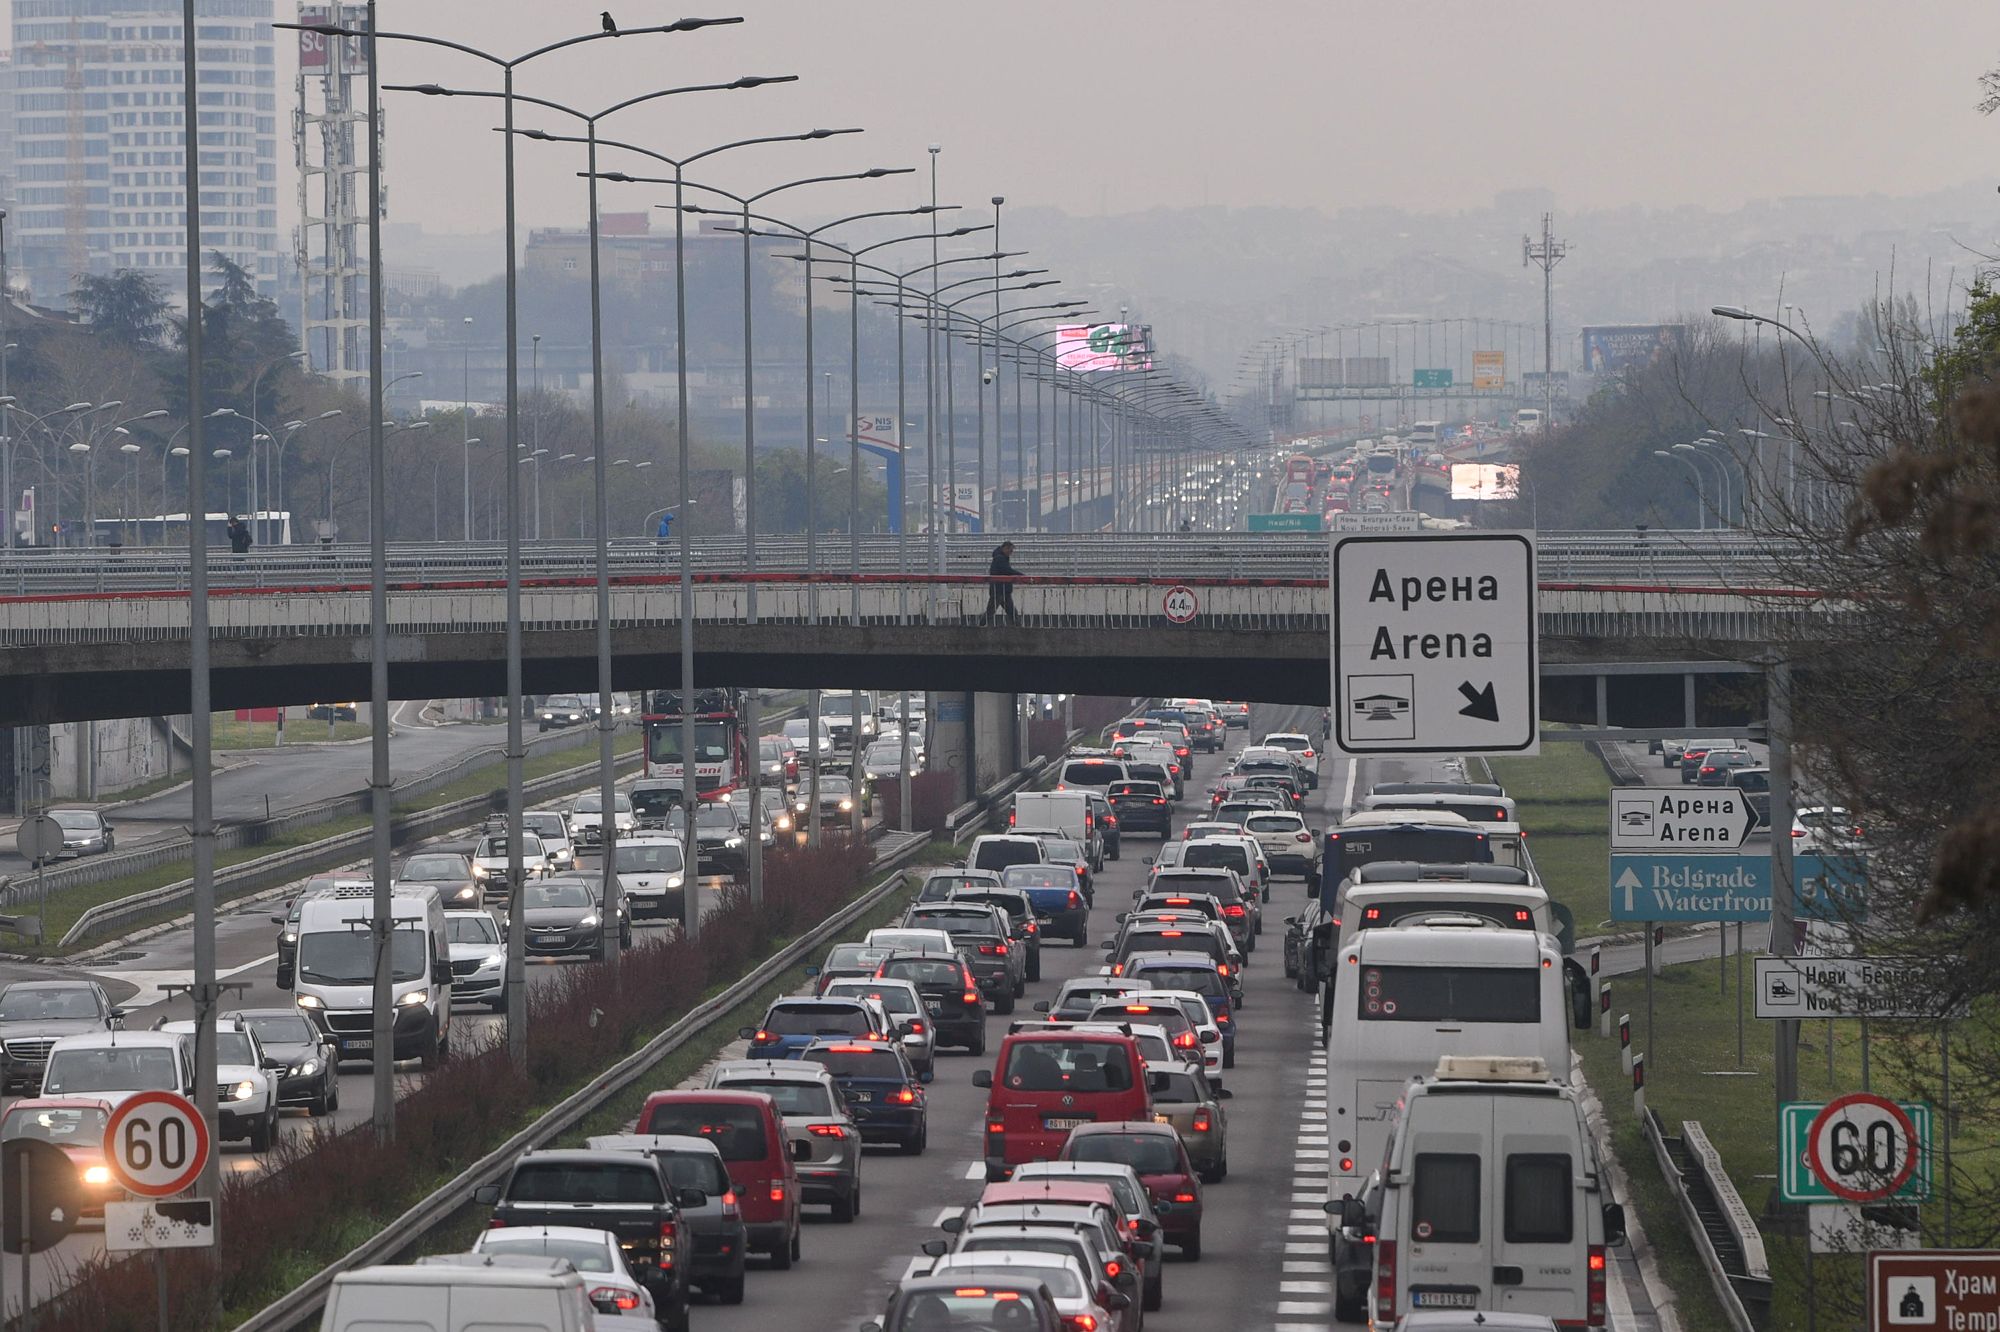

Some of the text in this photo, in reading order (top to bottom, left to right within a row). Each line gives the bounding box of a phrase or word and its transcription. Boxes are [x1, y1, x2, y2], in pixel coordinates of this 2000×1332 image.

[875, 417, 892, 425] NIS
[958, 487, 972, 495] NIS
[1369, 568, 1498, 611] Арена
[1370, 626, 1492, 660] Arena
[658, 765, 721, 775] Beani
[1659, 795, 1734, 818] Арена
[1660, 822, 1729, 841] Arena
[1652, 865, 1756, 891] Belgrade
[1652, 887, 1772, 912] Waterfron
[1806, 966, 1930, 984] Нови Београ
[125, 1117, 186, 1171] 60
[1830, 1120, 1896, 1176] 60
[1539, 1267, 1571, 1275] IVECO
[1944, 1268, 1997, 1301] Храм
